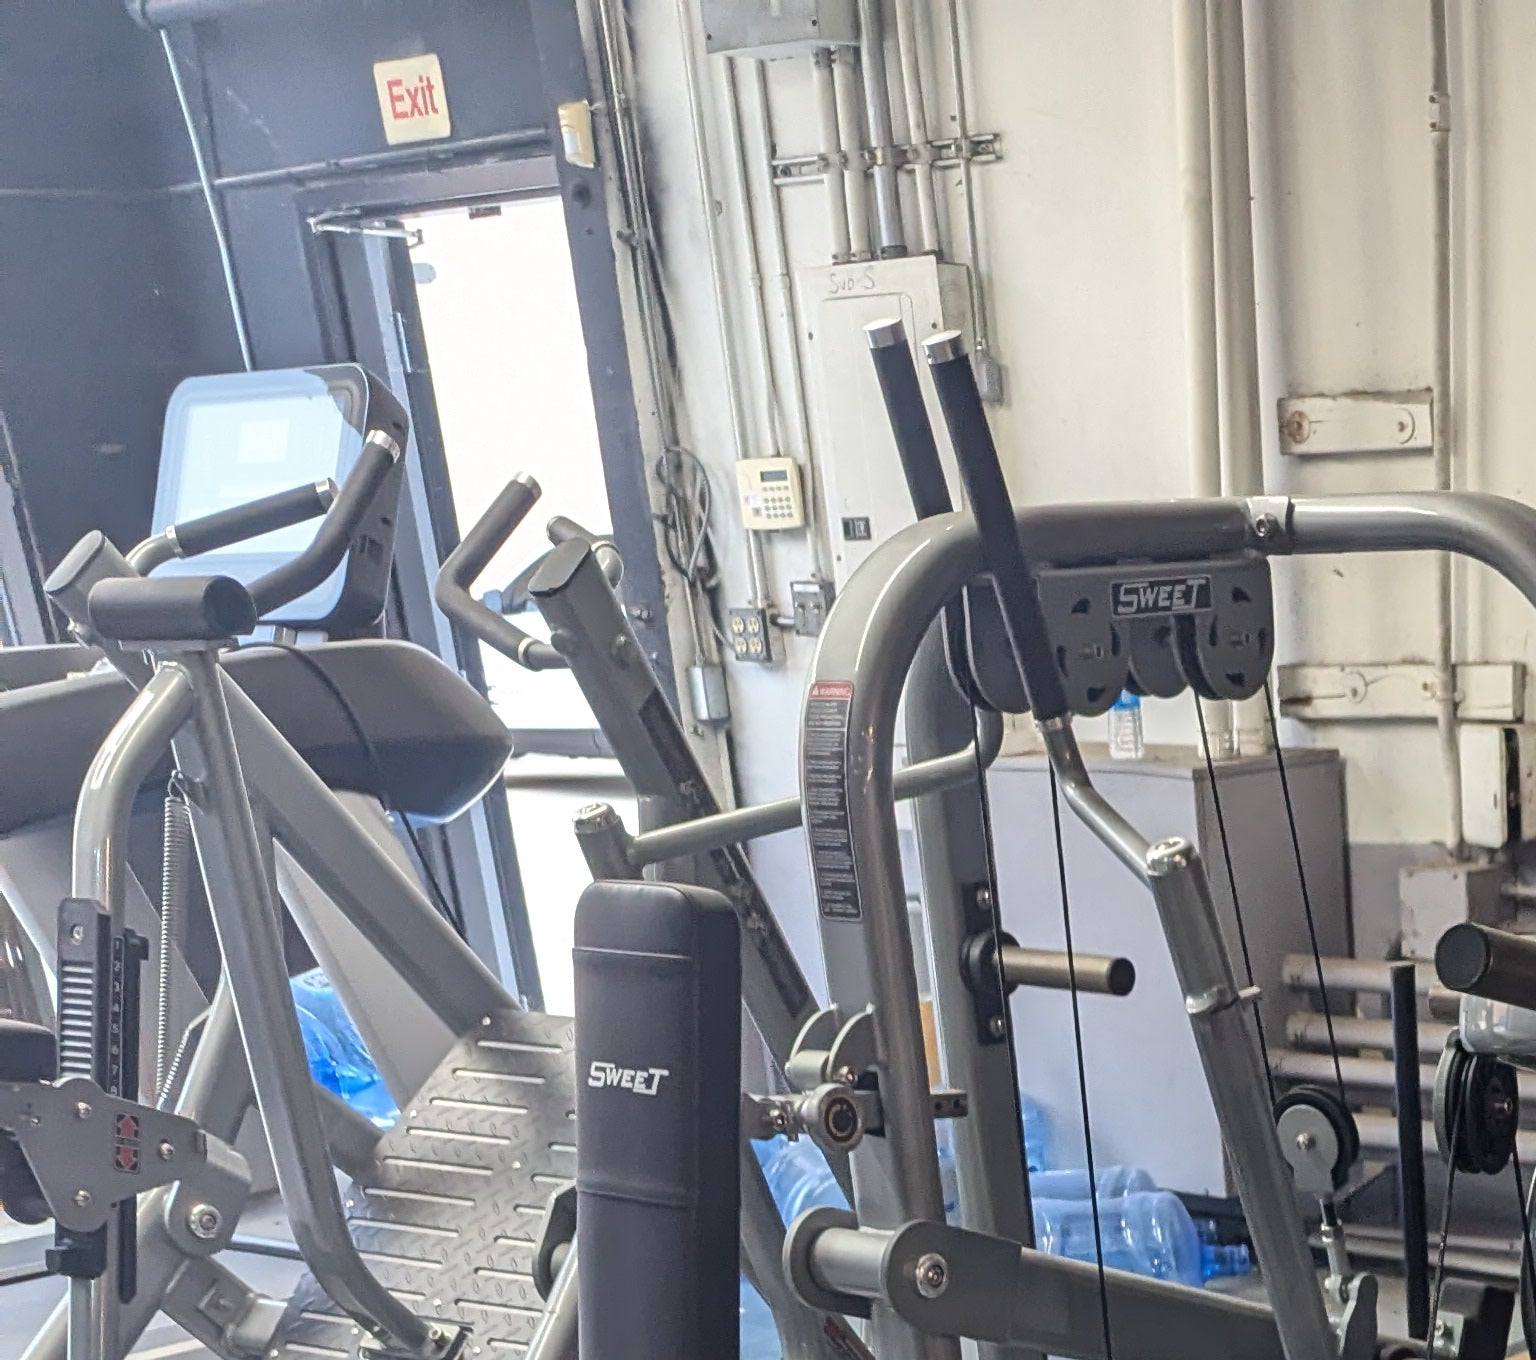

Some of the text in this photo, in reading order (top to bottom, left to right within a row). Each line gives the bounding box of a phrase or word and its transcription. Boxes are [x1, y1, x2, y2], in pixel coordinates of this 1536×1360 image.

[386, 74, 439, 120] Exit
[1117, 578, 1207, 614] SWEET
[587, 1060, 670, 1096] SWEET
